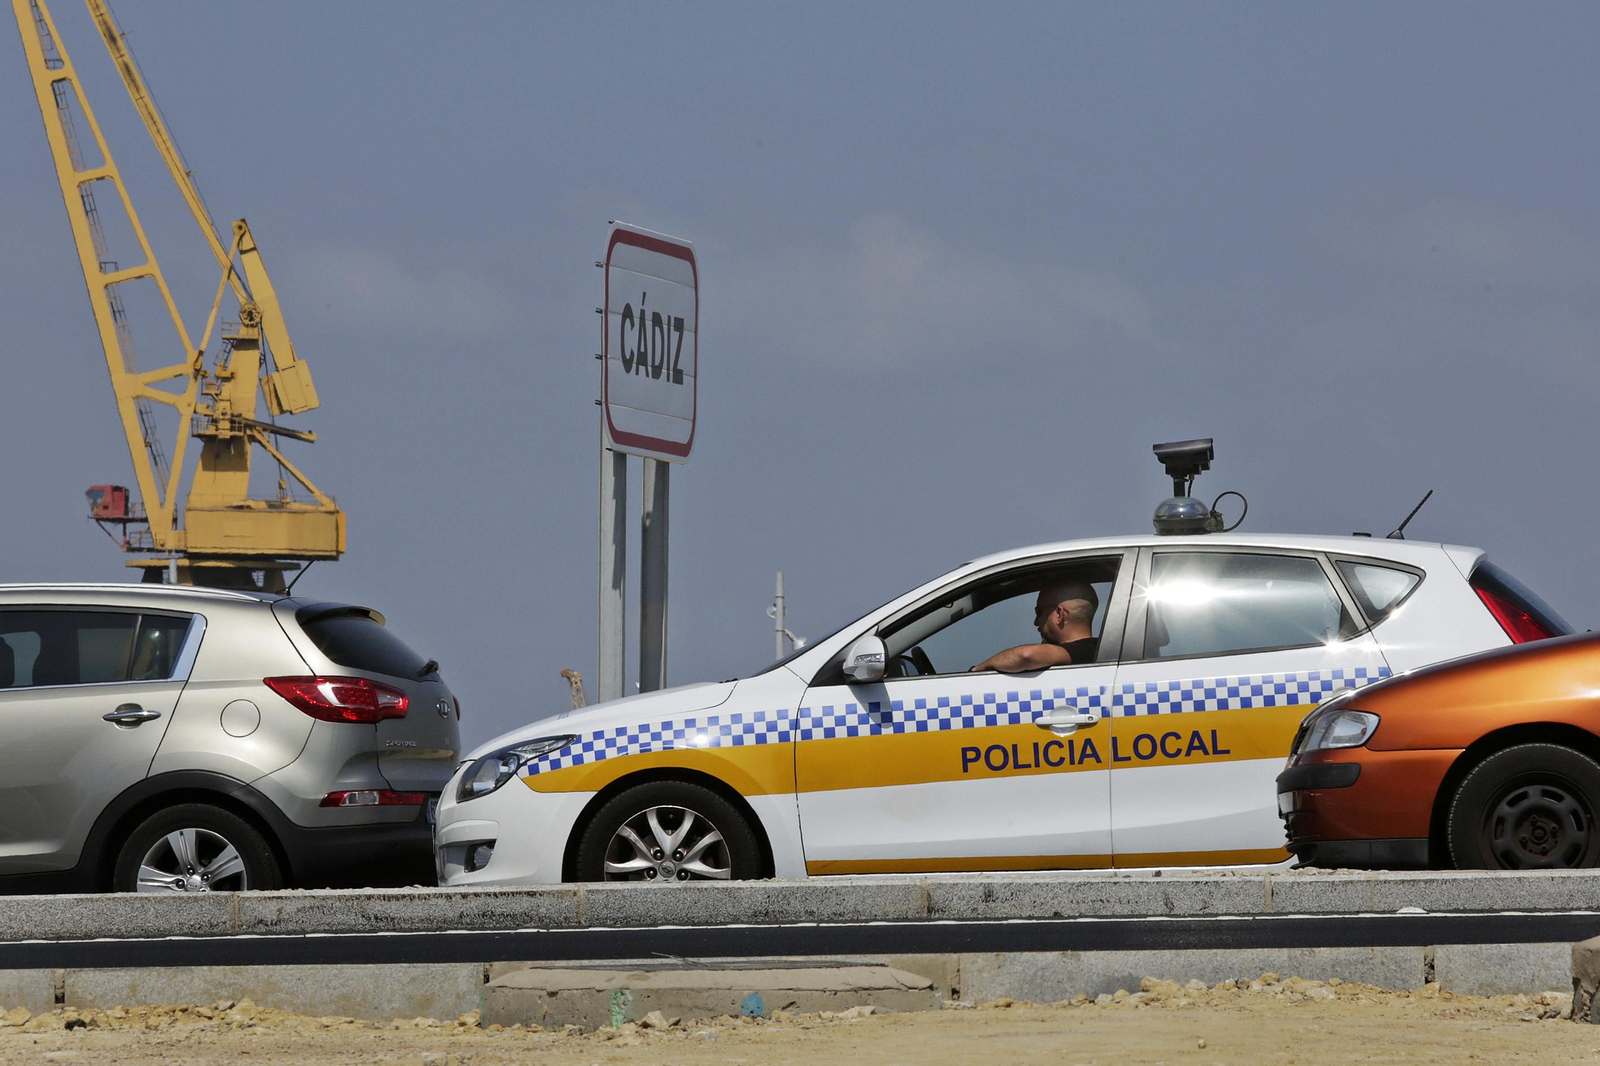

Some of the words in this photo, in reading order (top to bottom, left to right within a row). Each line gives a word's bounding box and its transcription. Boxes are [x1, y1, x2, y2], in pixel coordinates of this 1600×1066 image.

[620, 291, 684, 385] CÁDIZ
[960, 738, 1102, 773] POLICIA
[1111, 729, 1231, 762] LOCAL
